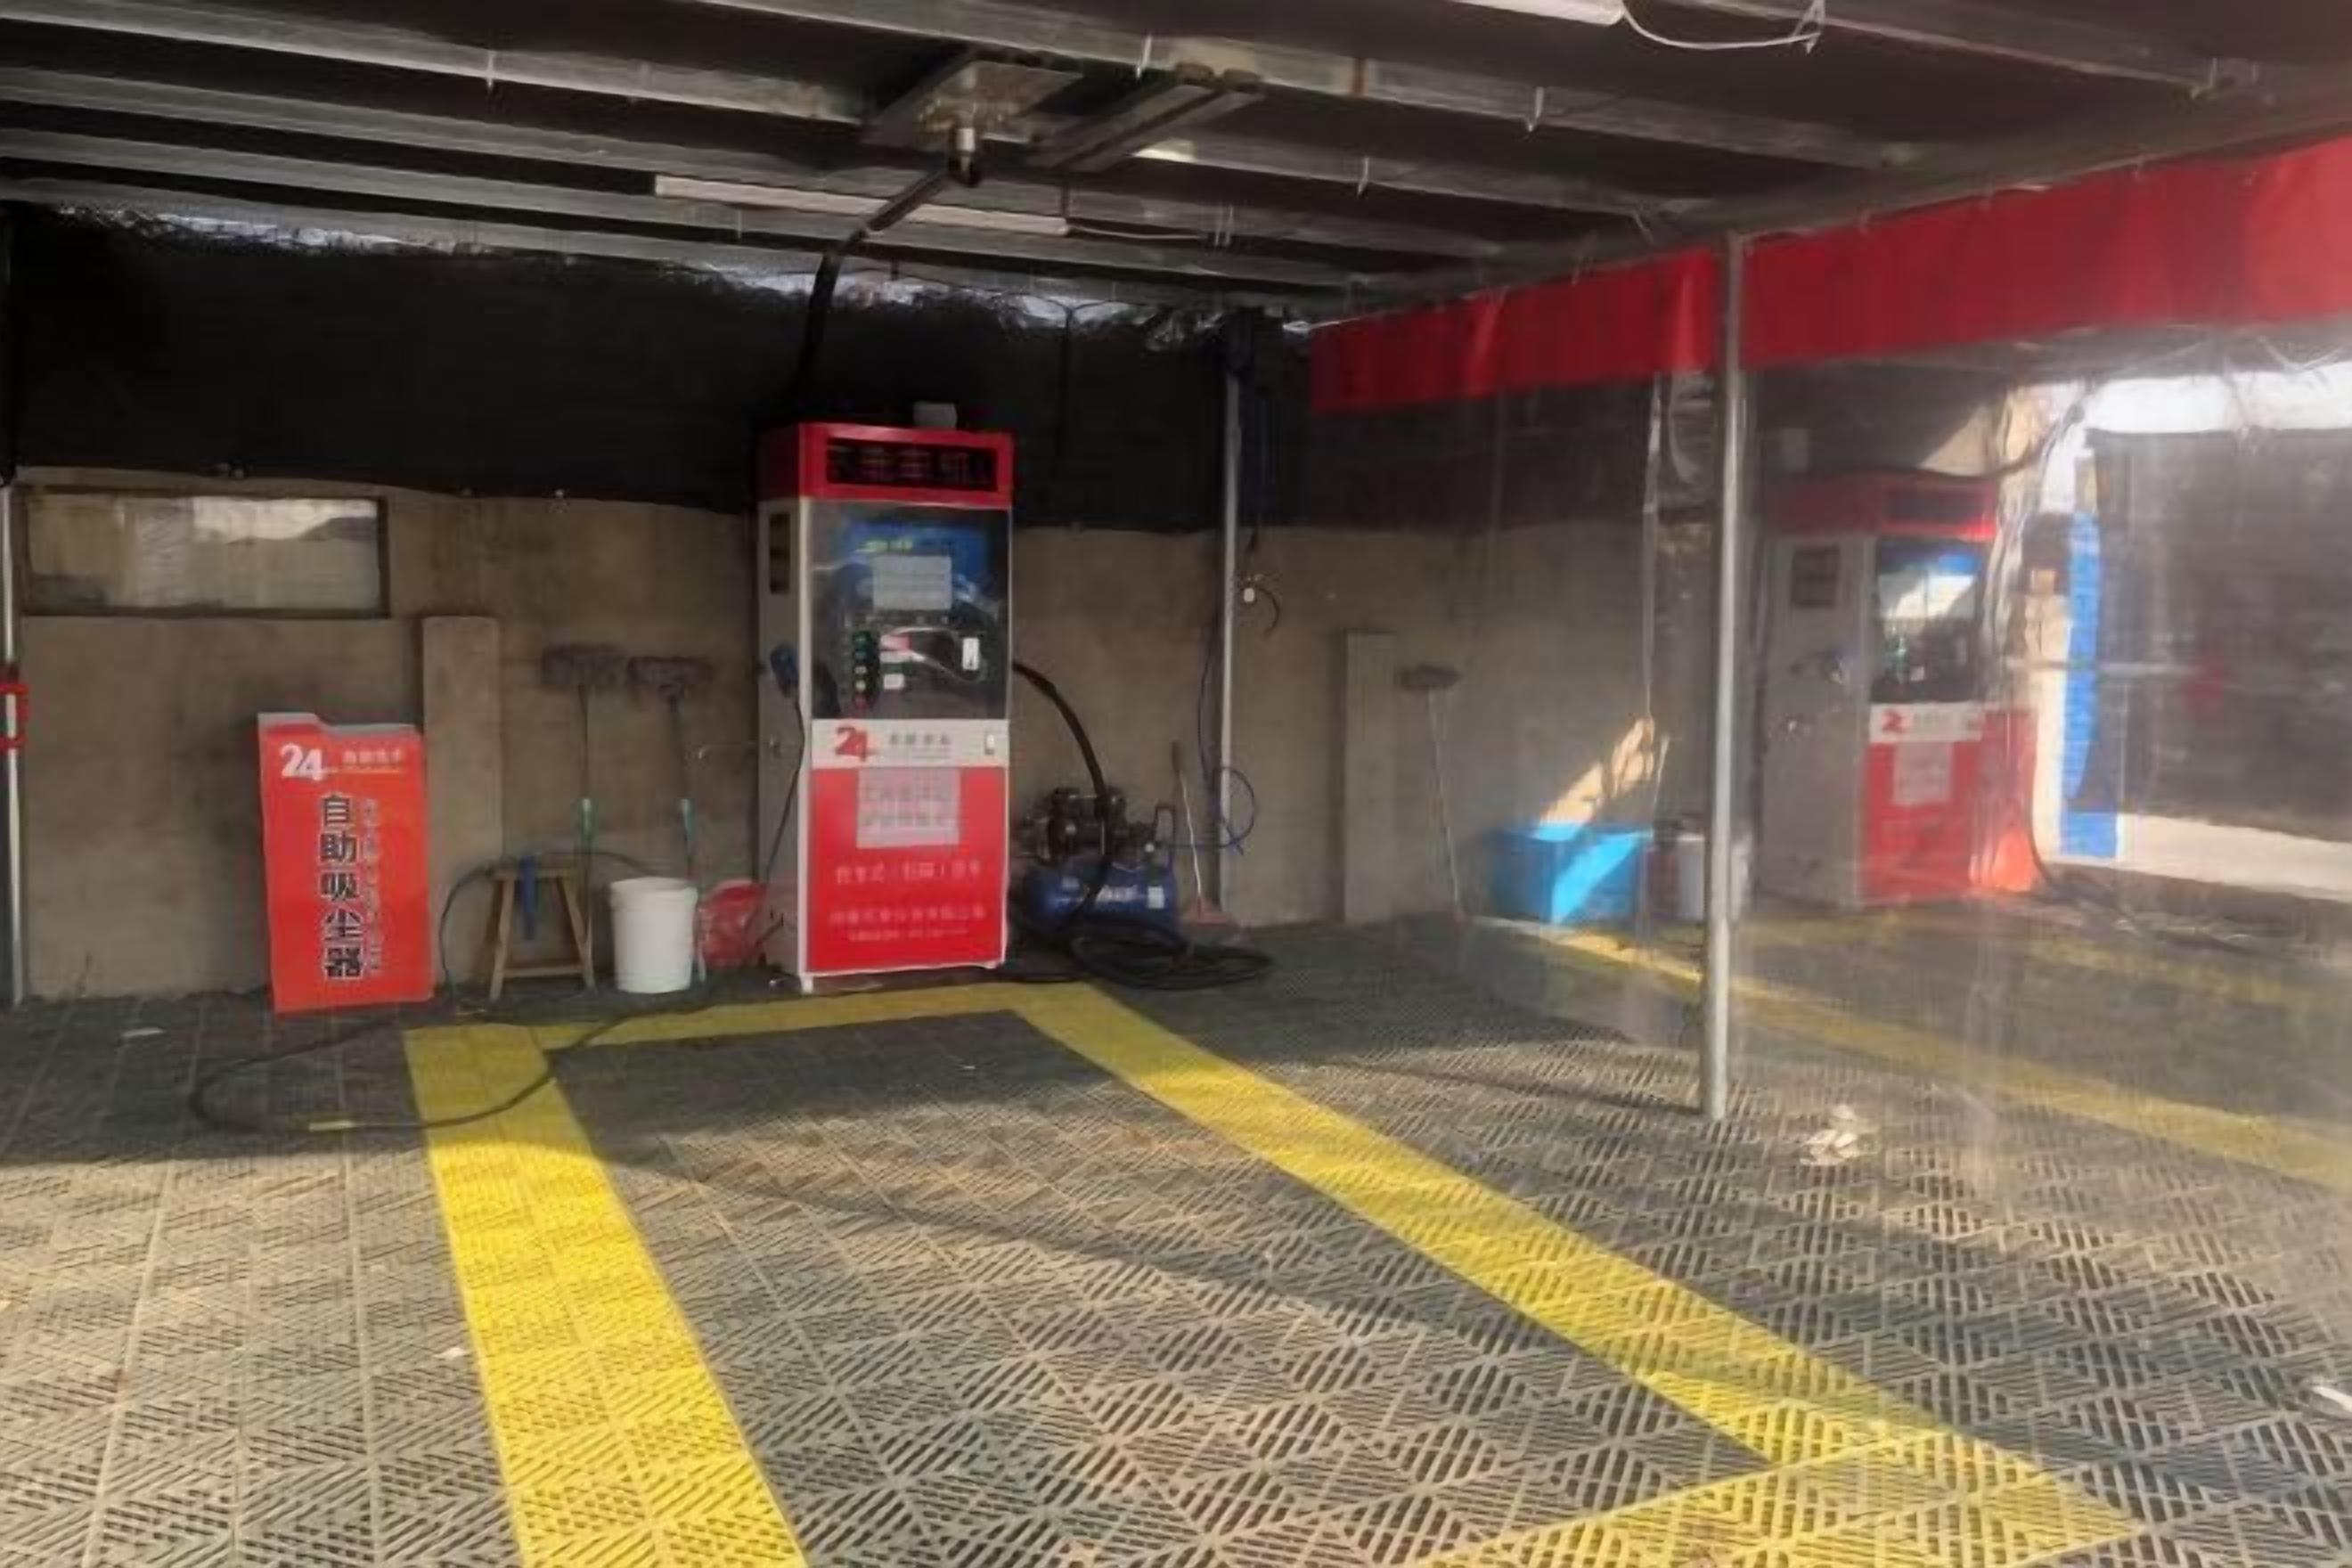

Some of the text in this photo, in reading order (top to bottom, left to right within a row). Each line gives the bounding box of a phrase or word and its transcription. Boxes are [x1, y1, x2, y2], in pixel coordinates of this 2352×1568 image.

[279, 743, 324, 781] 24
[320, 791, 364, 979] 自助吸尘器
